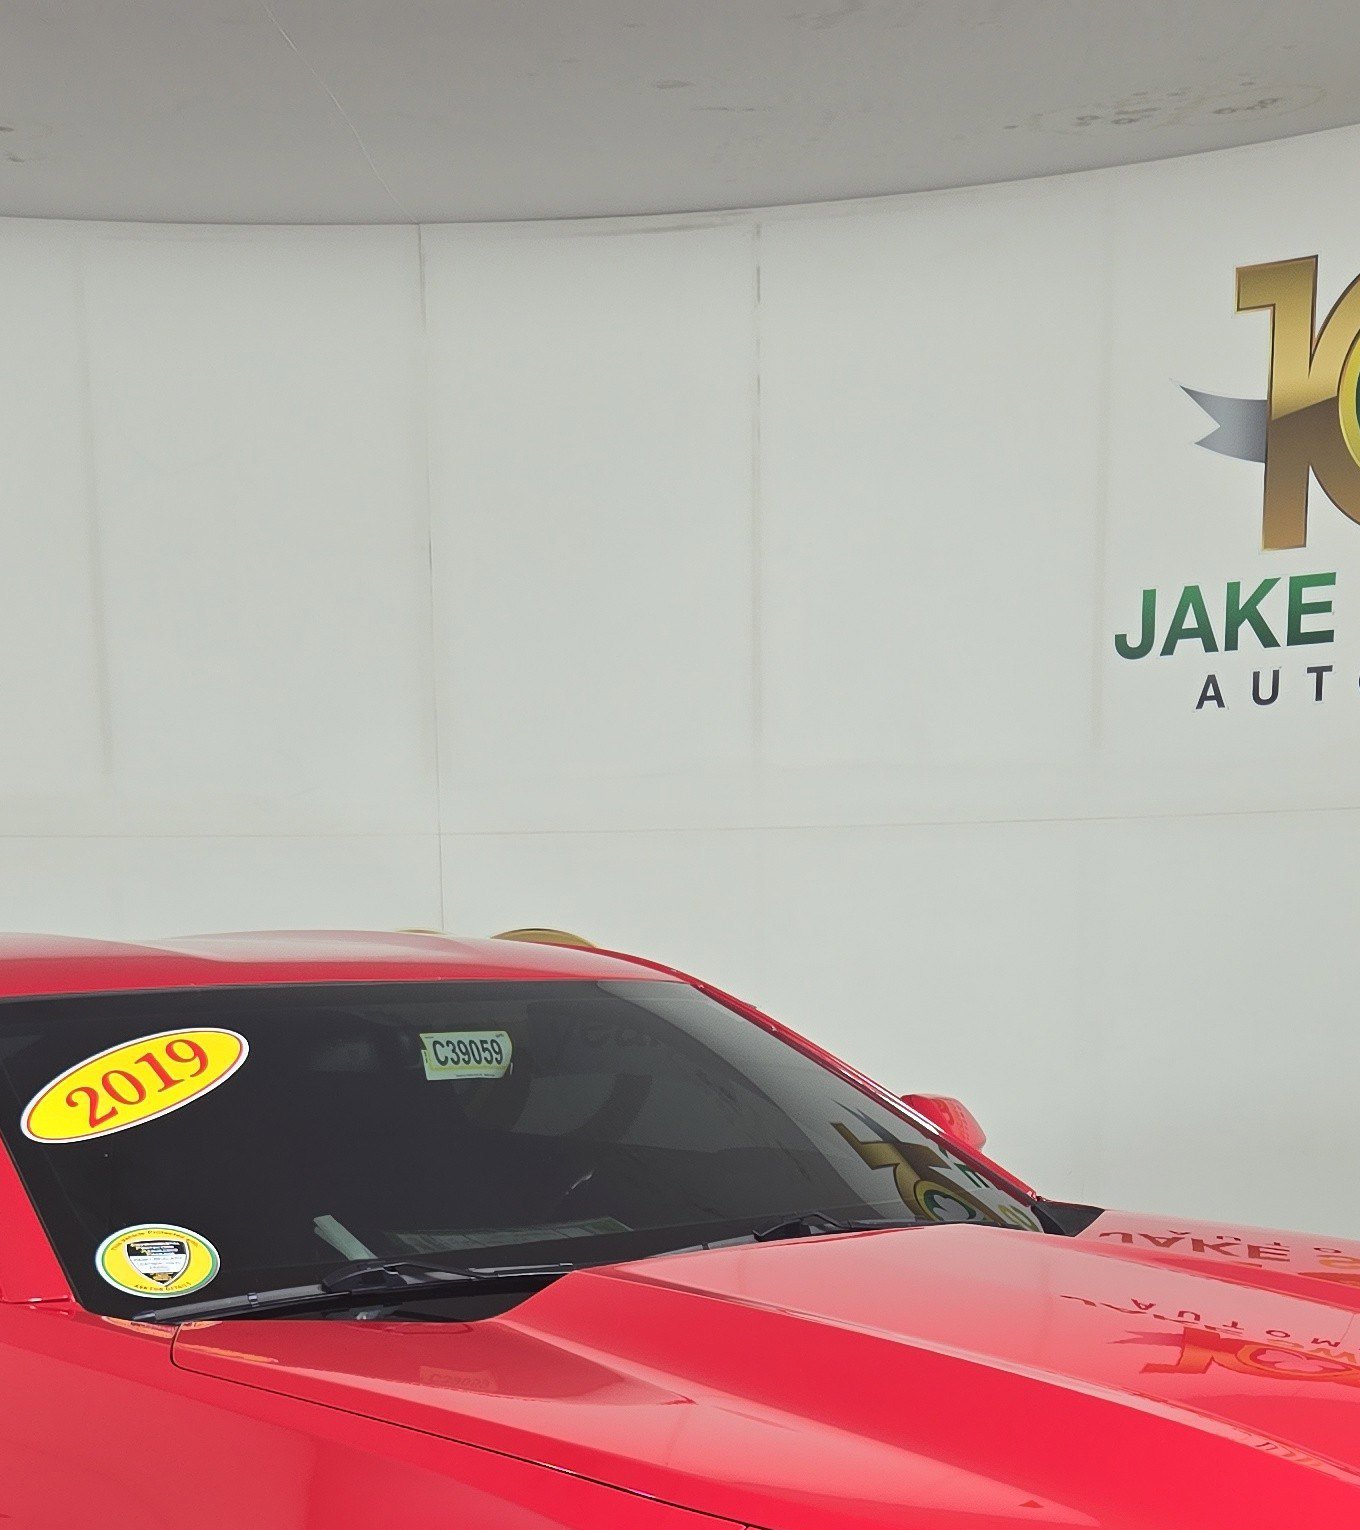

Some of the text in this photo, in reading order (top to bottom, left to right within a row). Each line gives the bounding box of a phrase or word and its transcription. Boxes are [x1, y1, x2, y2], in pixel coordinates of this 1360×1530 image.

[1114, 571, 1337, 661] JAKE
[65, 1038, 209, 1128] 2019
[432, 1038, 504, 1067] C39059
